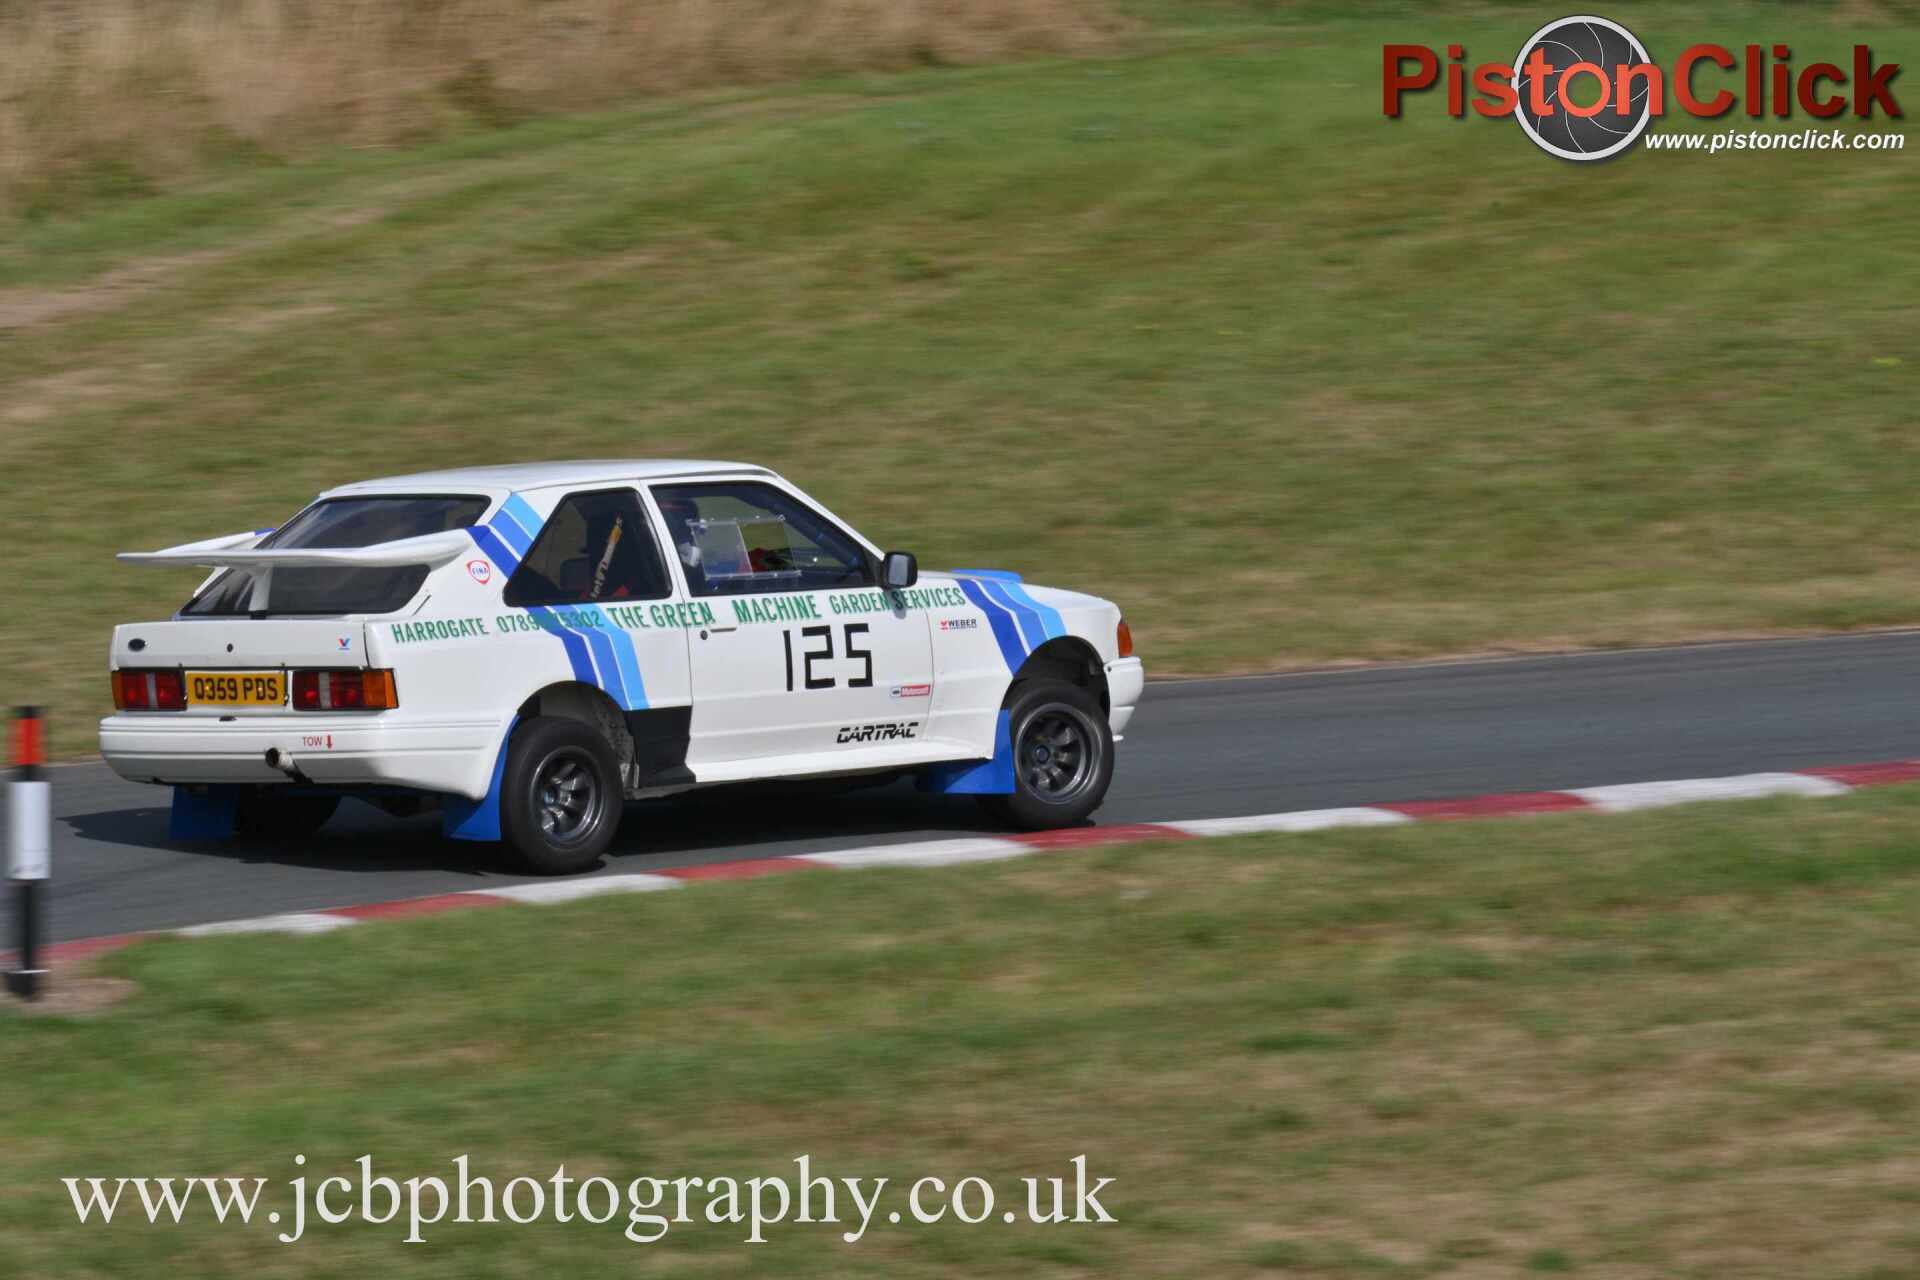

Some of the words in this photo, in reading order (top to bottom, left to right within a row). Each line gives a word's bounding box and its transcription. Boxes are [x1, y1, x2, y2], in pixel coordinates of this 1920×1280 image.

[391, 617, 489, 644] HARROGATE
[606, 604, 650, 629] THE
[649, 600, 716, 628] GREEN
[731, 594, 823, 624] MACHINE
[828, 594, 892, 615] GARDEN
[891, 587, 966, 610] SERVICES
[783, 623, 873, 692] 125
[242, 678, 278, 701] PDS
[302, 736, 323, 747] TOW
